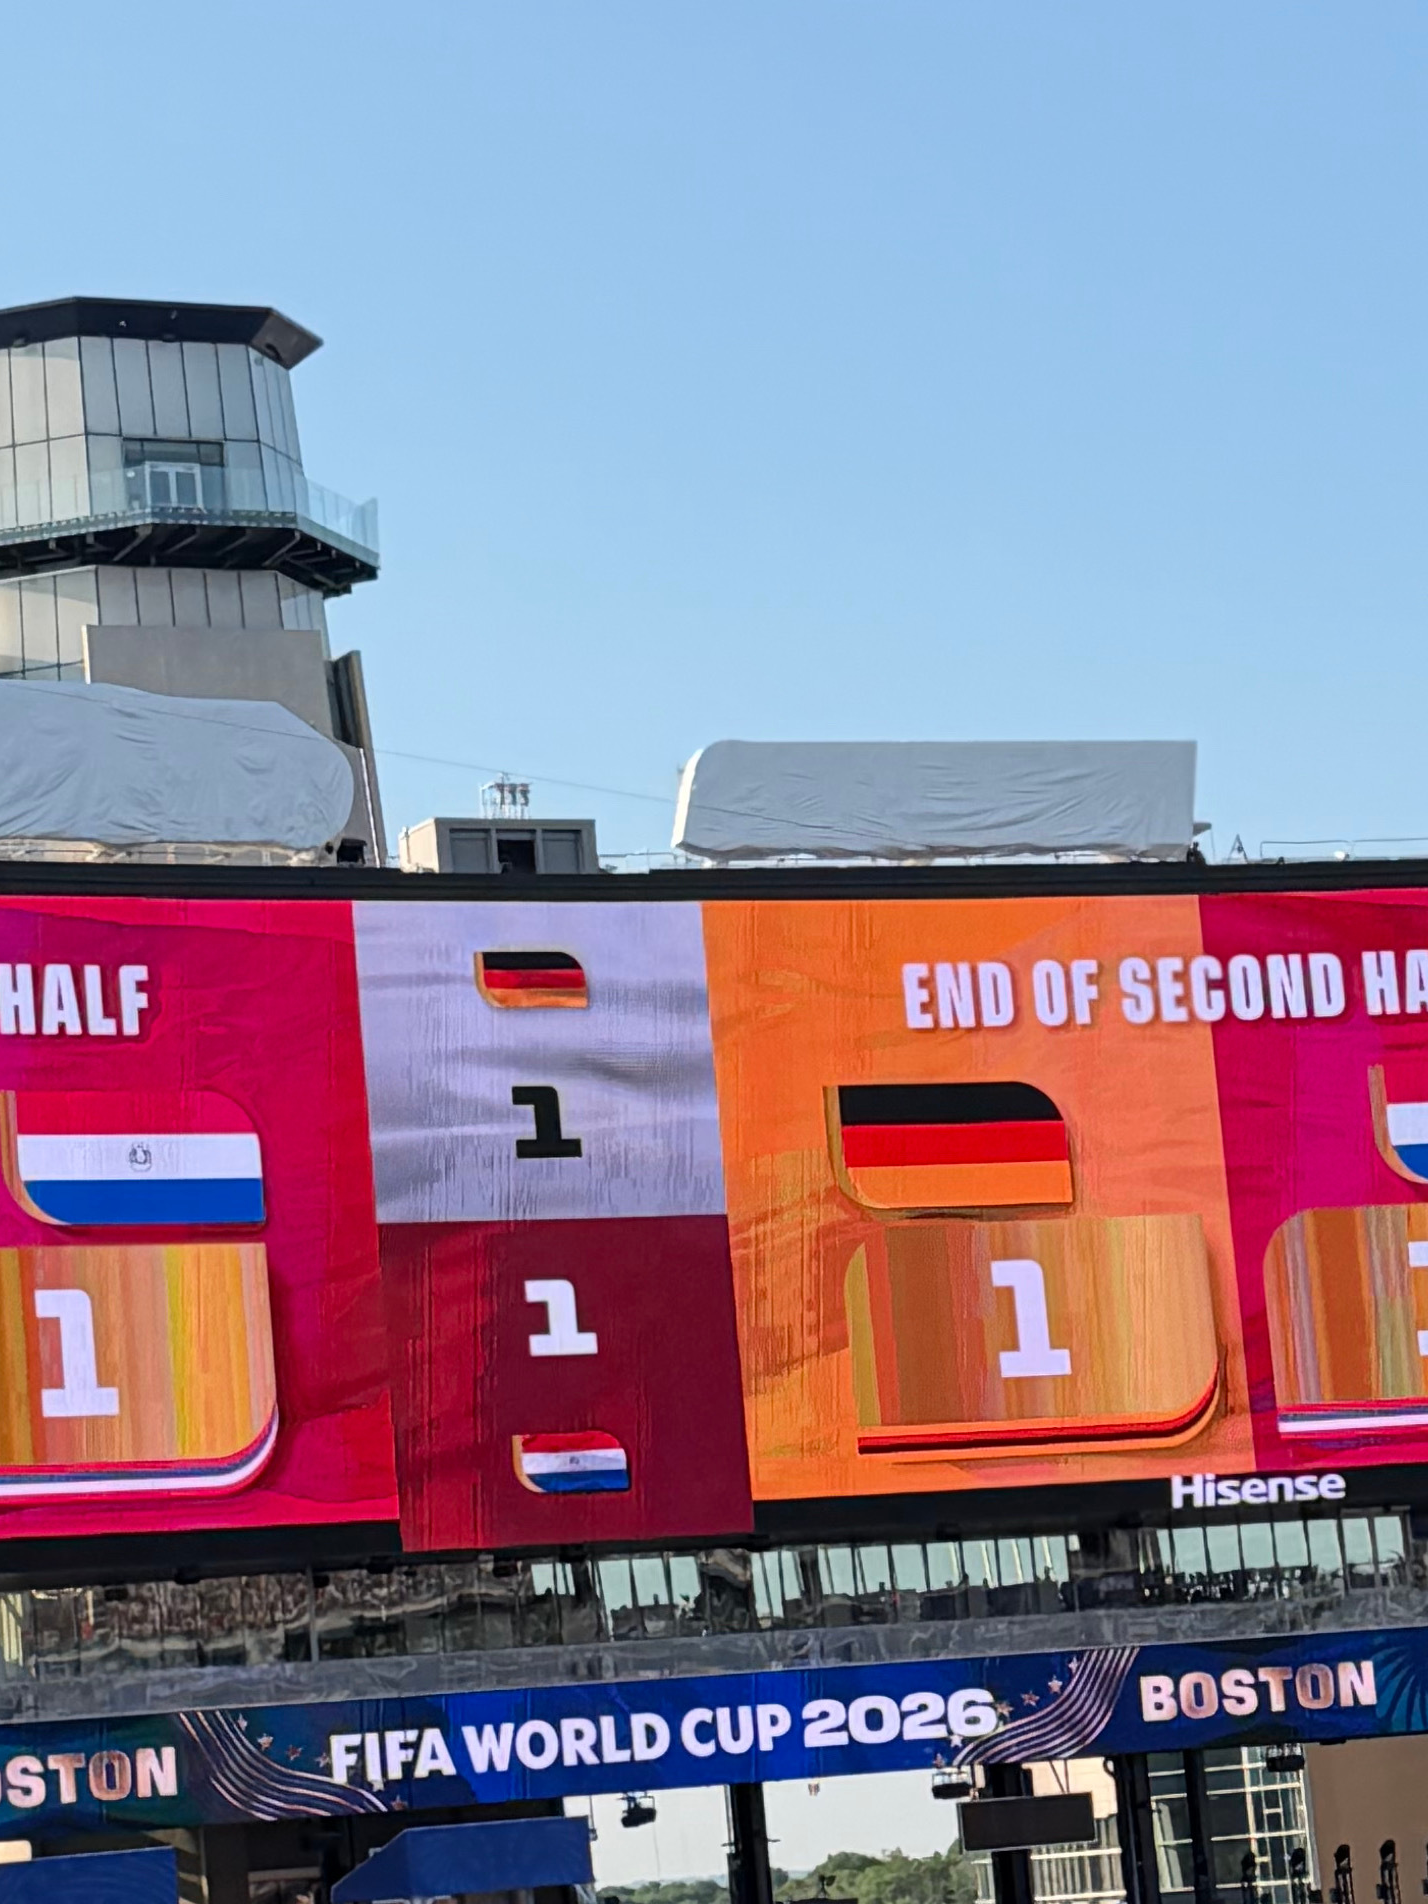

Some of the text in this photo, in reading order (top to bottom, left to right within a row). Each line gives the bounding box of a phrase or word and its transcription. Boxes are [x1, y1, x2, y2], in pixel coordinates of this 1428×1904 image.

[902, 962, 1014, 1029] END
[1032, 959, 1099, 1027] OF
[1119, 953, 1344, 1024] SECOND
[511, 1085, 583, 1158] 1
[34, 1289, 120, 1418] 1
[523, 1279, 597, 1356] 1
[992, 1259, 1072, 1377] 1
[1171, 1471, 1346, 1508] Hisense
[1140, 1660, 1378, 1722] BOSTON
[329, 1688, 998, 1786] FIFA WORLD CUP 2026
